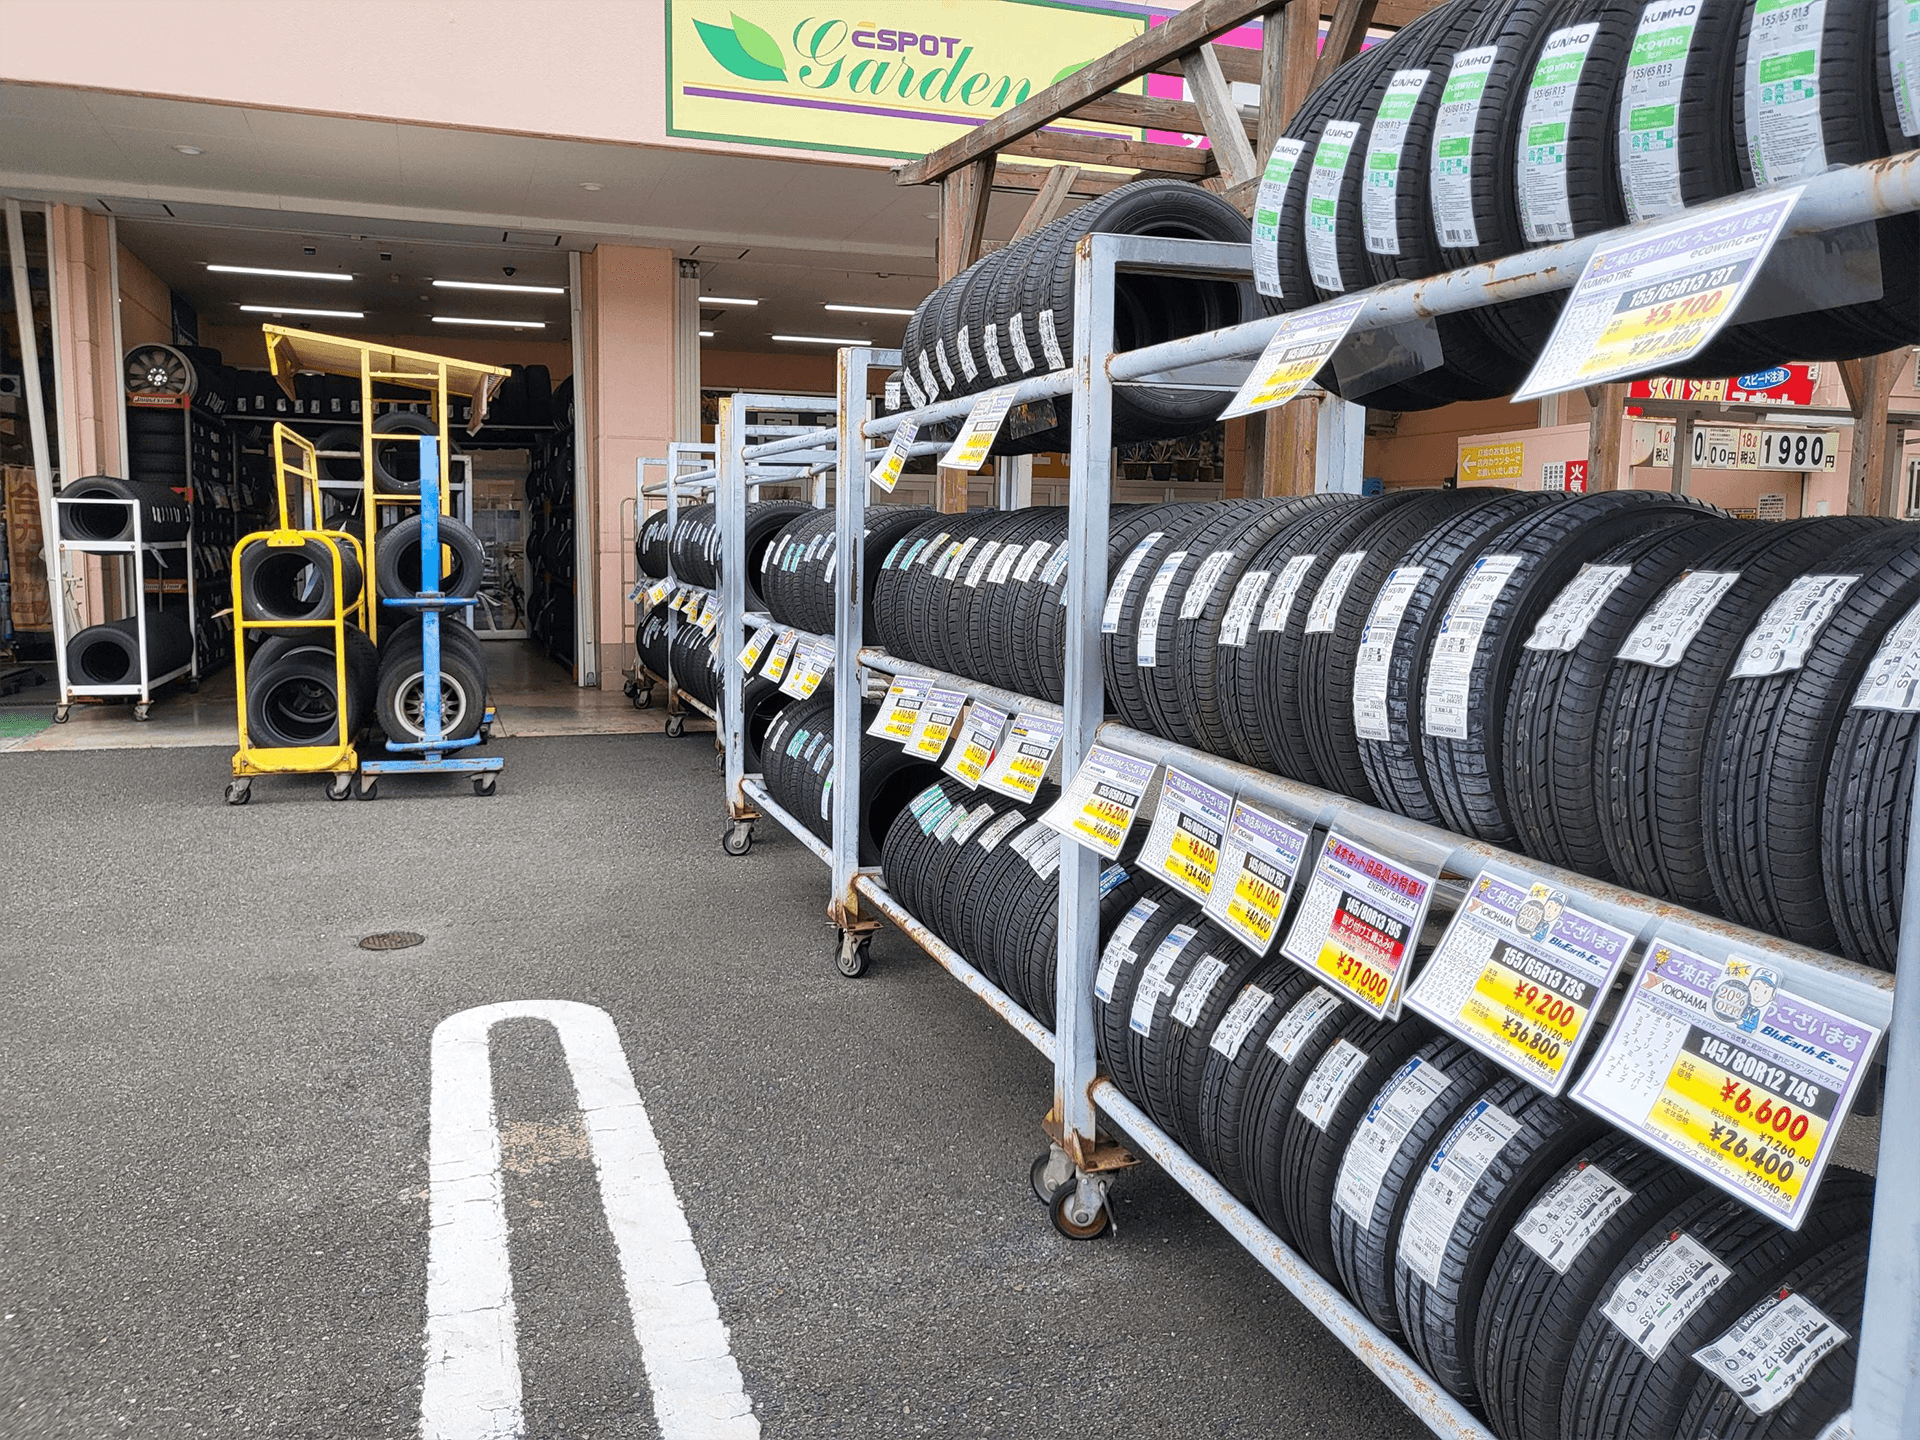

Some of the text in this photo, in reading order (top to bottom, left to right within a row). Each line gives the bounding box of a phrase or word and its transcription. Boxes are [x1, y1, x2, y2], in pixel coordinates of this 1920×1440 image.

[1642, 5, 1696, 25] KUMHO
[1761, 6, 1810, 27] 155/65 R13
[1545, 33, 1590, 52] KUMHO
[792, 17, 1031, 108] Garden
[1453, 55, 1492, 70] KUMHO
[1632, 63, 1672, 79] 155/65 R13
[1603, 208, 1779, 271] ご来店ありがとうございます
[1581, 268, 1634, 290] KUMHO TIRE
[1629, 264, 1737, 307] 155/65R13 73T
[1644, 290, 1722, 326] ¥5,700
[1744, 369, 1789, 386] スピード注油
[1655, 448, 1670, 462] 税込
[1740, 451, 1756, 465] 税込
[1096, 800, 1128, 822] ¥15,200
[1188, 838, 1215, 864] ¥8,600
[1327, 863, 1351, 879] MICHELIN
[1247, 877, 1280, 909] ¥10,100
[1366, 879, 1416, 911] ENERGY SAVER 4
[1245, 908, 1271, 933] ¥40,400
[1345, 897, 1386, 929] 145/80R13
[1384, 917, 1402, 939] 79S
[1479, 905, 1513, 928] YOKOHAMA
[1521, 903, 1546, 919] 20%
[1548, 936, 1599, 965] BluEarth-Es
[1336, 951, 1387, 997] ¥37,000
[1502, 947, 1585, 1000] 155/65R13 73S
[1513, 980, 1574, 1026] ¥9,200
[1660, 982, 1707, 1011] YOKOHAMA
[1716, 1000, 1742, 1018] OFF!
[1718, 986, 1747, 1007] 20%
[1502, 1015, 1560, 1060] ¥36,800
[1760, 1025, 1835, 1064] BluEarth-Es
[1676, 1067, 1692, 1081] 価格
[1680, 1060, 1695, 1072] 本体
[1700, 1036, 1819, 1107] 145/80R12 74S
[1400, 1085, 1411, 1095] R13
[1405, 1079, 1427, 1097] 145/80
[1407, 1104, 1420, 1115] 79S
[1660, 1096, 1690, 1115] 4本セット
[1663, 1107, 1689, 1125] 本体価格
[1720, 1078, 1808, 1141] ¥6,600
[1466, 1131, 1479, 1142] R13
[1472, 1123, 1496, 1143] 145/80
[1475, 1151, 1489, 1164] 79S
[1709, 1122, 1794, 1182] ¥26,400
[1547, 1183, 1608, 1245] 155/65R13 73S
[1579, 1195, 1622, 1237] BluEarth-Es
[1638, 1258, 1703, 1327] 155/65R13 73S
[1672, 1273, 1719, 1322] BluEarth-Es
[1740, 1296, 1779, 1327] YOKOHAMA
[1740, 1319, 1818, 1387] 145/80R12 74S
[1783, 1335, 1839, 1387] BluEarth-Es
